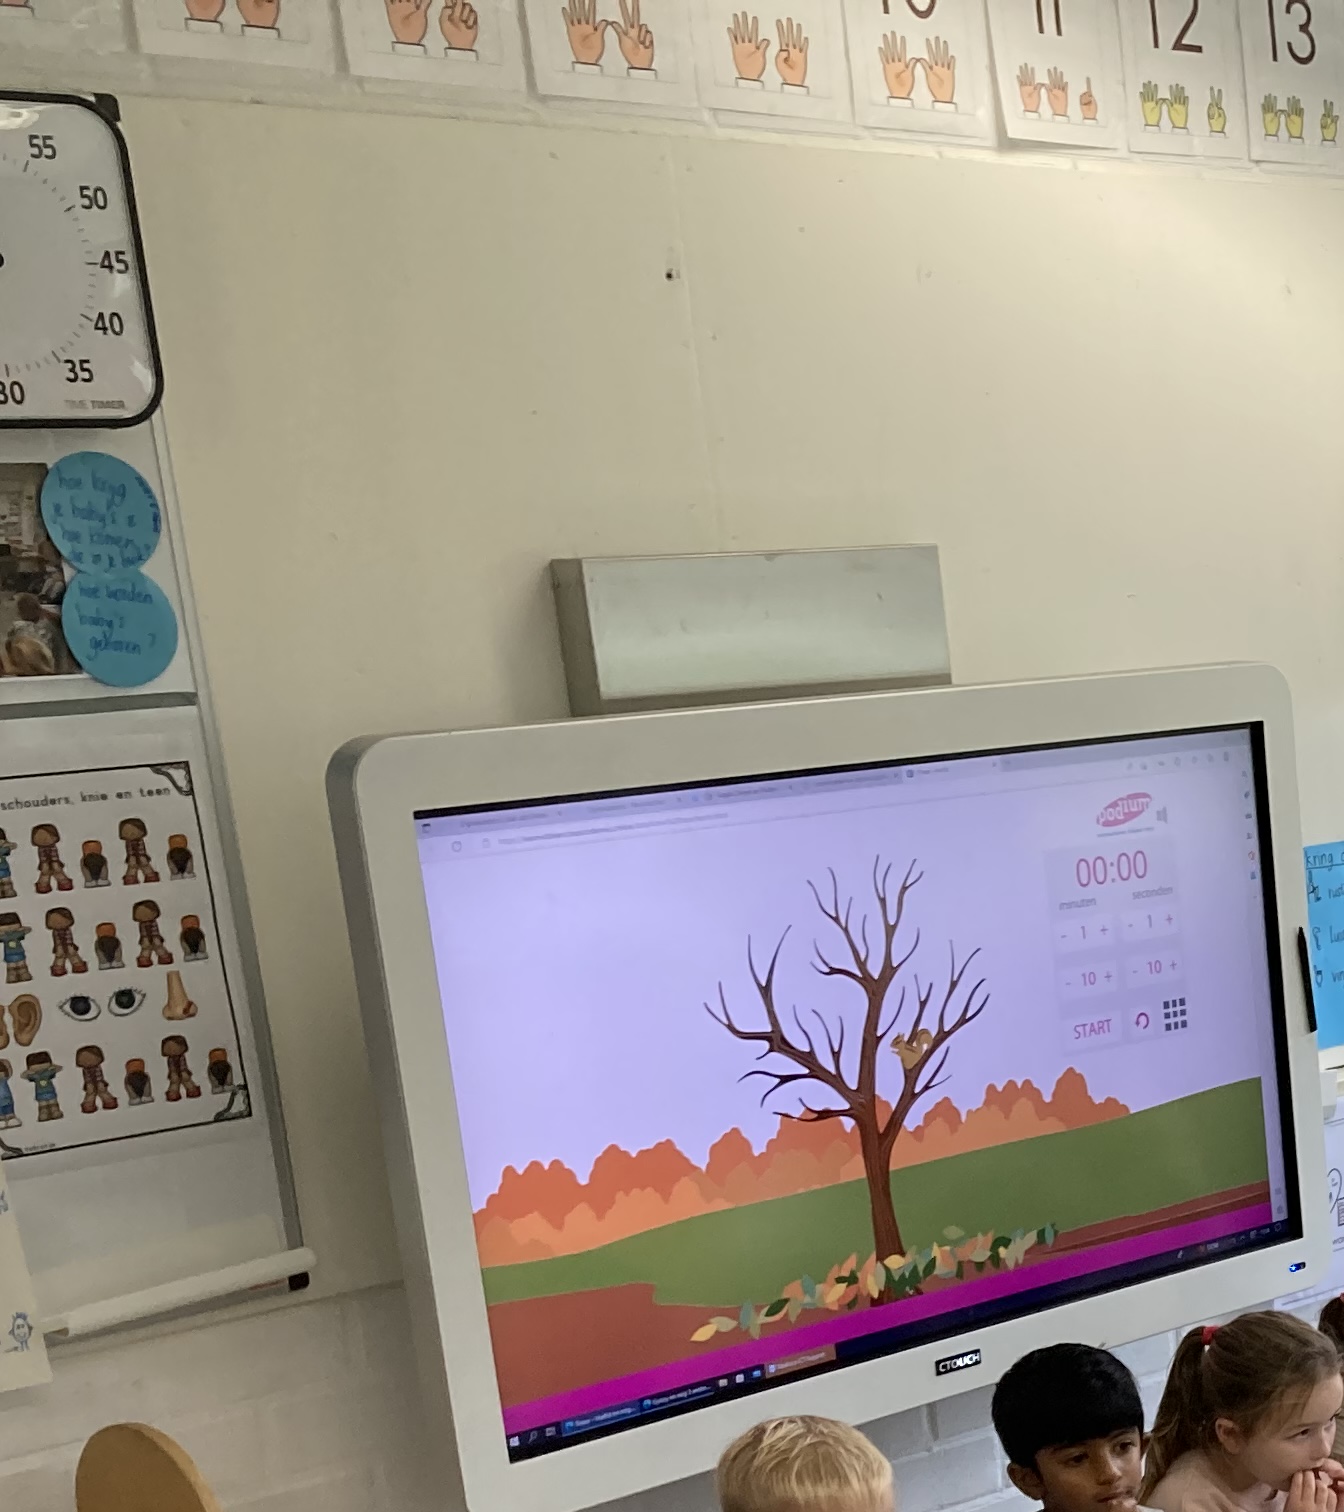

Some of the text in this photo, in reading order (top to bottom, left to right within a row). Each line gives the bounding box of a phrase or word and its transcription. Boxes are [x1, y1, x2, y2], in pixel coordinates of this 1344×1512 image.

[1150, 0, 1203, 53] 12
[1267, 0, 1316, 65] 13
[28, 134, 56, 160] 55
[79, 185, 108, 210] 50
[99, 250, 129, 274] 45
[94, 311, 124, 336] 40
[63, 359, 94, 383] 35
[115, 790, 133, 799] en
[139, 787, 171, 798] teen
[1098, 797, 1152, 826] podium
[1076, 850, 1147, 888] 00:00
[1305, 851, 1333, 871] kring
[1132, 886, 1173, 900] seconden
[1081, 972, 1097, 987] 10
[1148, 960, 1162, 975] 10
[1074, 1019, 1112, 1040] START
[938, 1353, 980, 1373] CTOUCH
